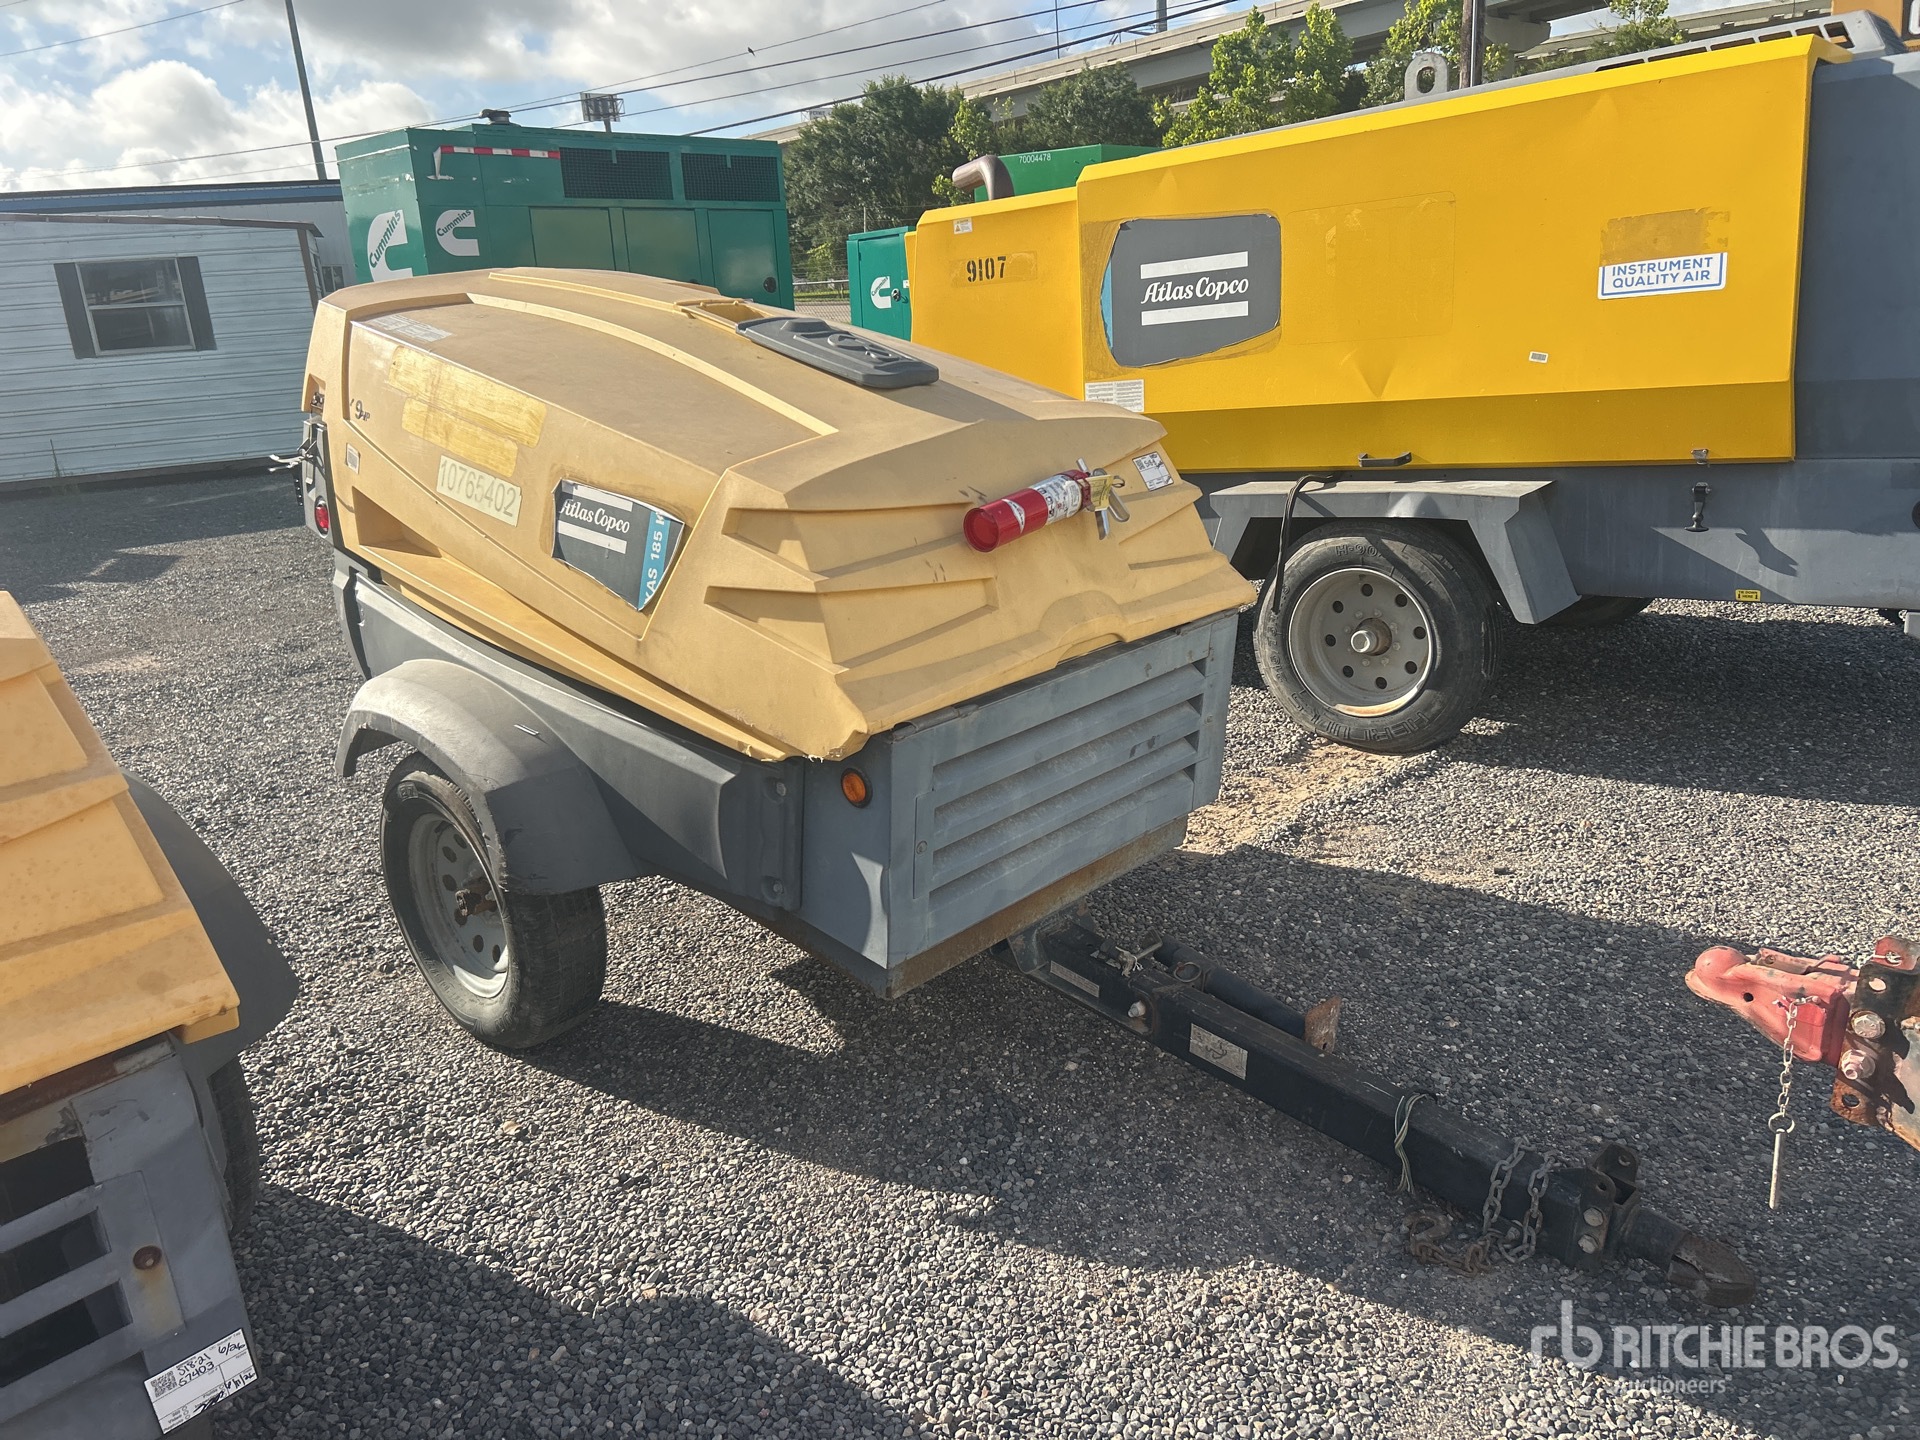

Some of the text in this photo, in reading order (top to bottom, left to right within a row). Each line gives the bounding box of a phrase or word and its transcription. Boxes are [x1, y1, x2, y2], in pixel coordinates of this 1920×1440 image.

[1018, 153, 1052, 164] 70004478
[436, 208, 472, 237] Cummins
[369, 209, 402, 269] Cummins
[966, 256, 1007, 283] 9107
[1612, 256, 1713, 277] INSTRUMENT
[1612, 269, 1711, 288] QUALITY AIR
[1140, 276, 1249, 304] Atlas Copco
[440, 461, 517, 518] 10765402
[560, 499, 630, 533] Atlas Copco
[650, 530, 663, 561] 185
